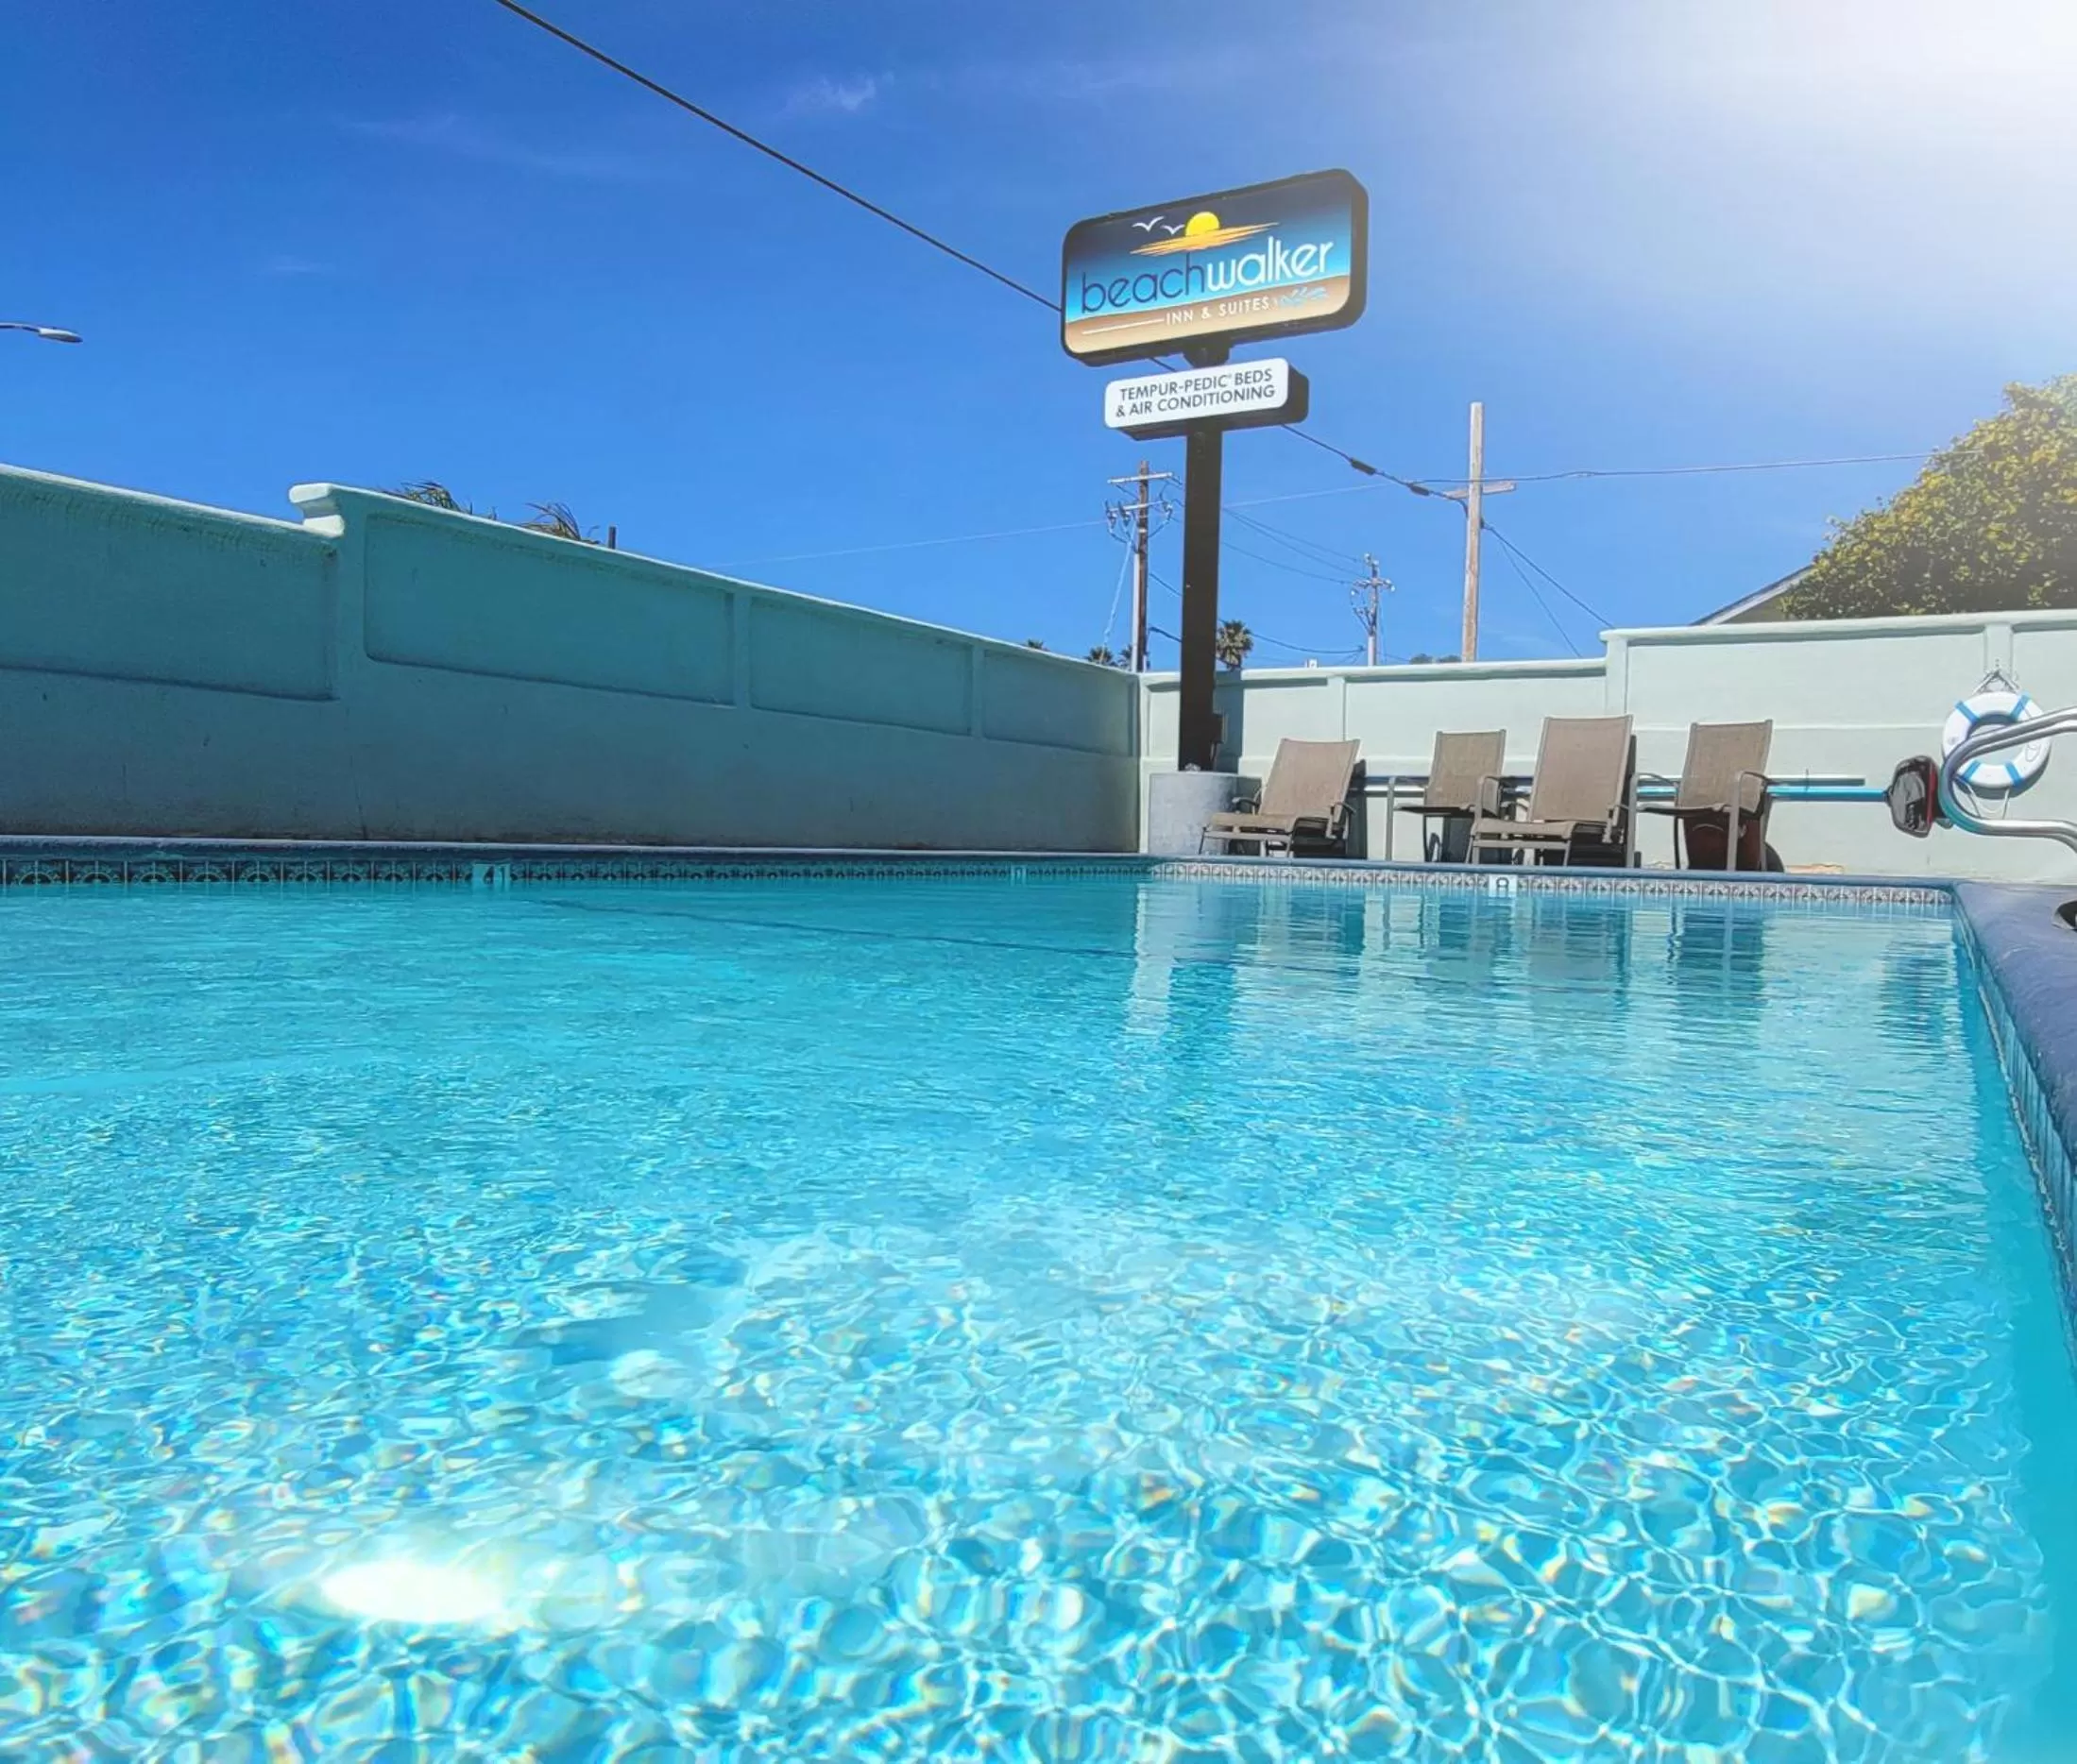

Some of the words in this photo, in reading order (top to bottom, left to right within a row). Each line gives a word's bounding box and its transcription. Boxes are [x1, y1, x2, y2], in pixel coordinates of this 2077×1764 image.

[1081, 236, 1334, 314] beachwalker
[1166, 310, 1193, 327] INN
[1200, 306, 1213, 320] &
[1218, 296, 1269, 317] SUITES
[1234, 368, 1273, 386] BEDS
[1115, 404, 1126, 417] &
[1129, 399, 1153, 416] AIR
[1157, 384, 1275, 413] CONDITIONING
